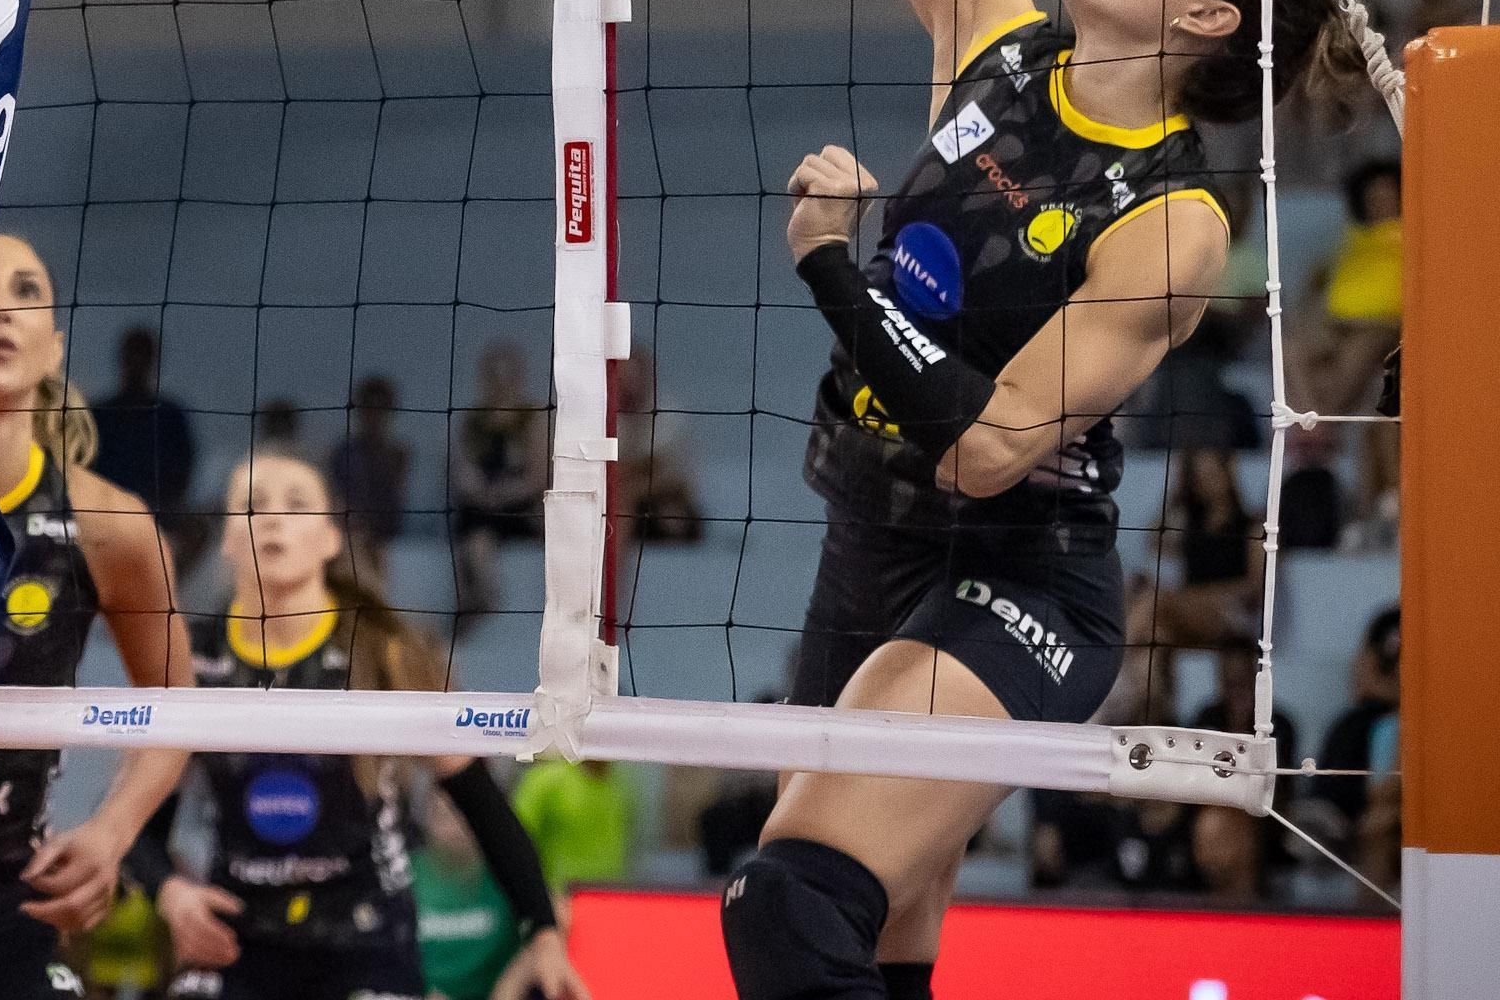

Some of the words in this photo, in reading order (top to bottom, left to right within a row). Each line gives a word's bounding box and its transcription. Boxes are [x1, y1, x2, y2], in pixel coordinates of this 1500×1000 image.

[568, 148, 587, 237] Pequita
[956, 579, 1075, 678] Dentil
[82, 704, 152, 726] Dentil
[456, 705, 531, 728] Dentil
